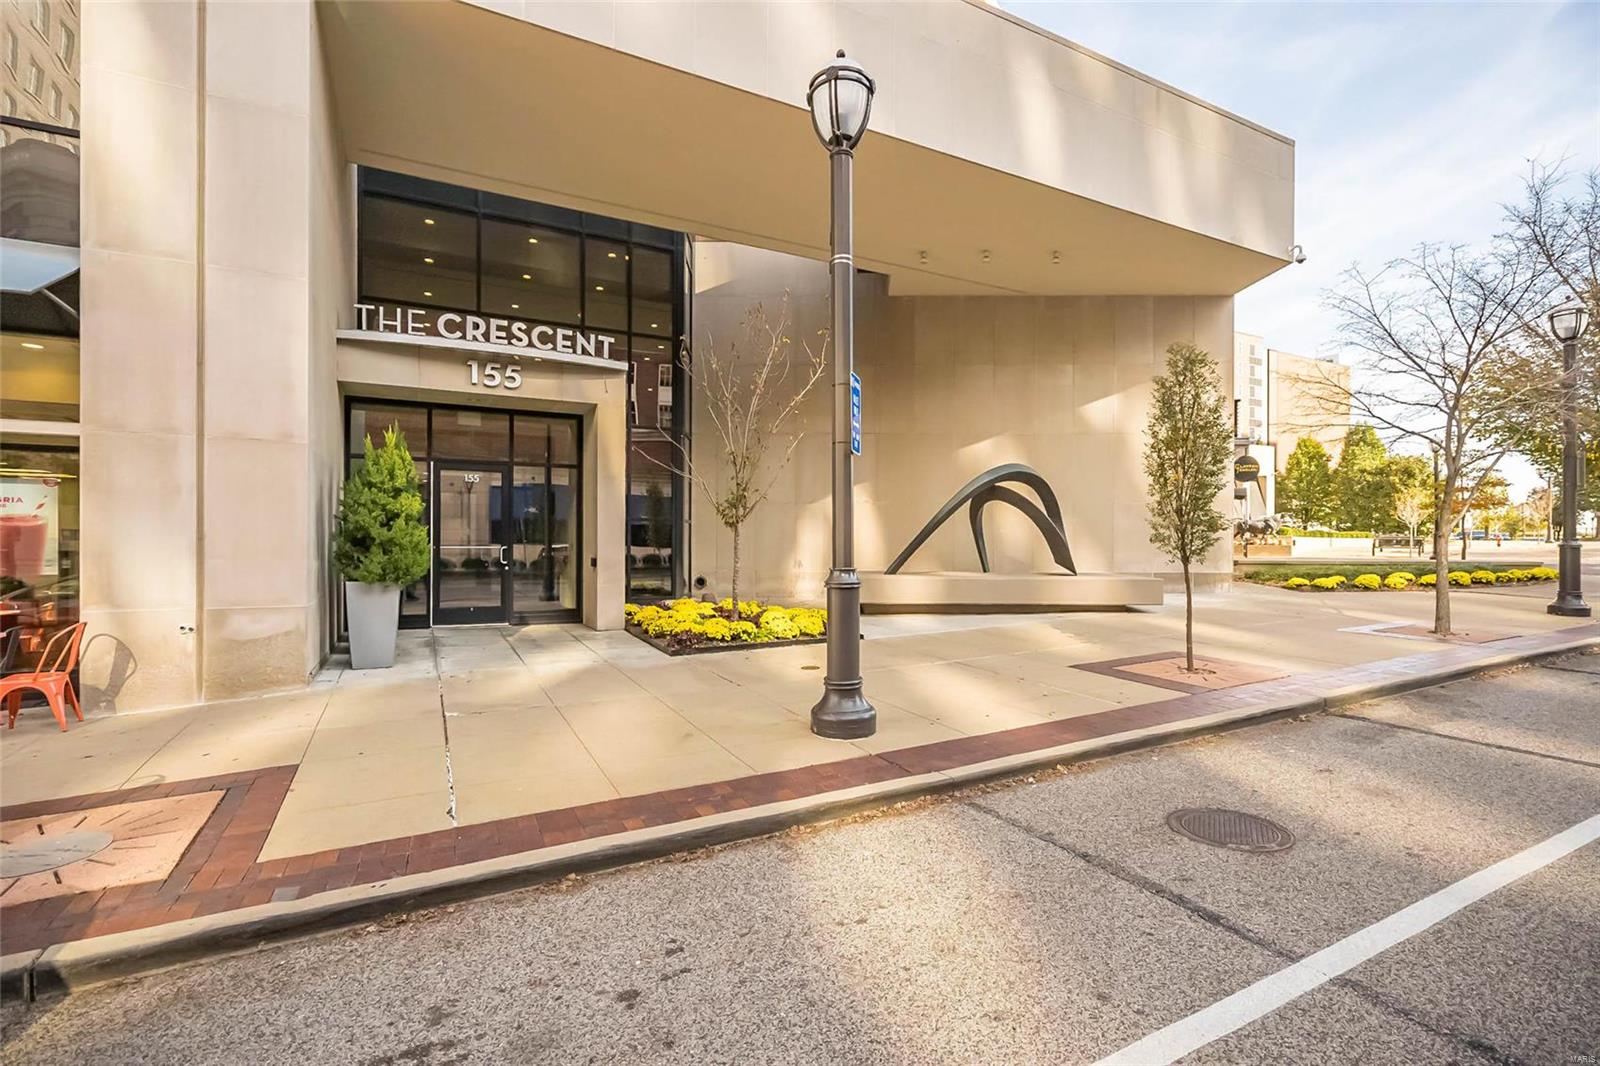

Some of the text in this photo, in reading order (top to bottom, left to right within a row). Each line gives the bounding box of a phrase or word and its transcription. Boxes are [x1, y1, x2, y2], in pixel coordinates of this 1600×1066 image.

[354, 304, 616, 359] THE CRESCENT
[467, 360, 522, 390] 155
[463, 473, 480, 483] 155
